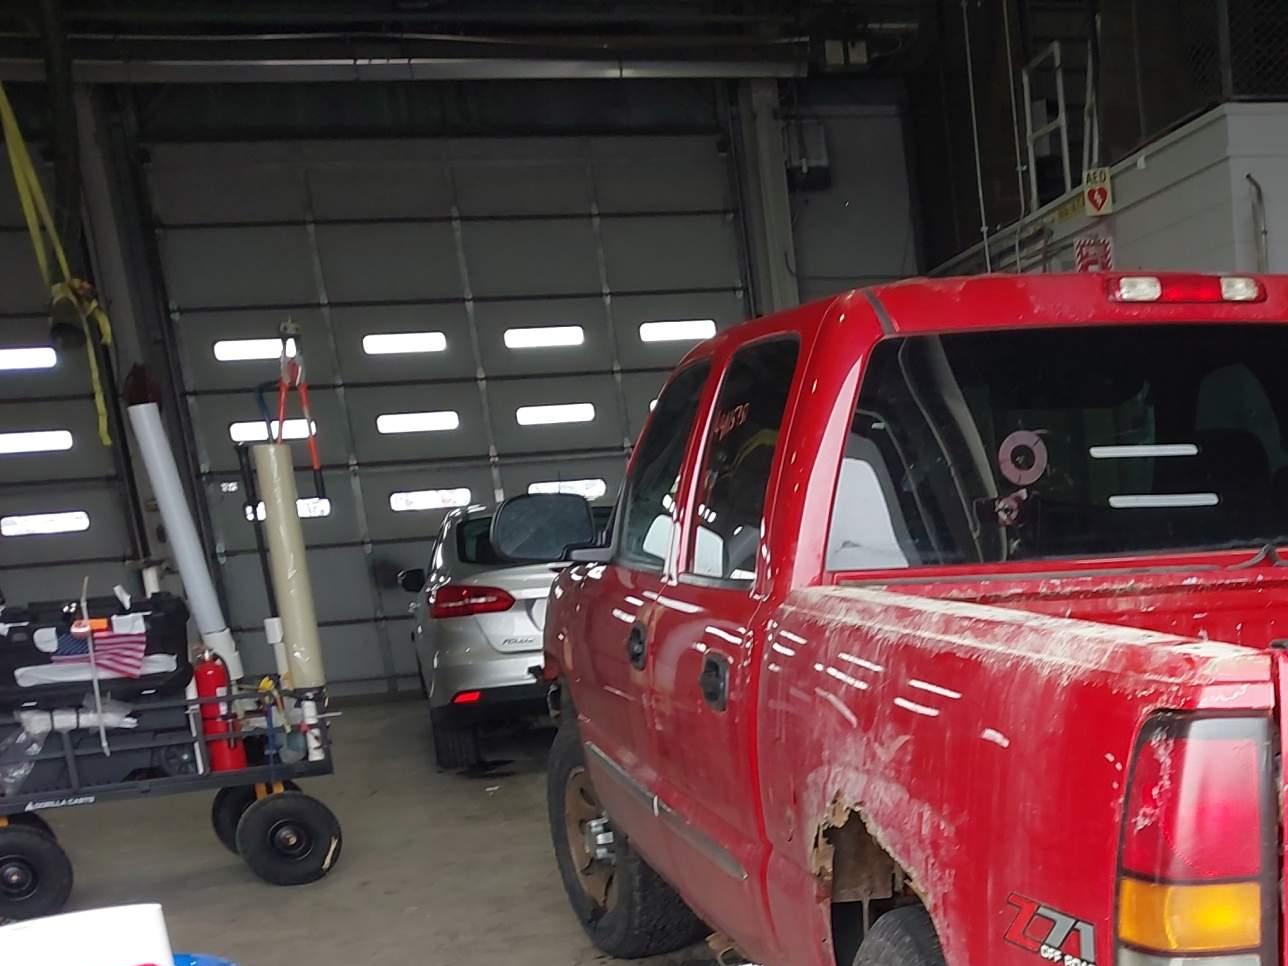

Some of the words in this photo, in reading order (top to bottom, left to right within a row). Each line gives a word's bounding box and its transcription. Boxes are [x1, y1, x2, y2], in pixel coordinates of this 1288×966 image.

[1086, 170, 1107, 185] AED
[1003, 892, 1097, 965] Z71
[1040, 944, 1063, 963] OFF
